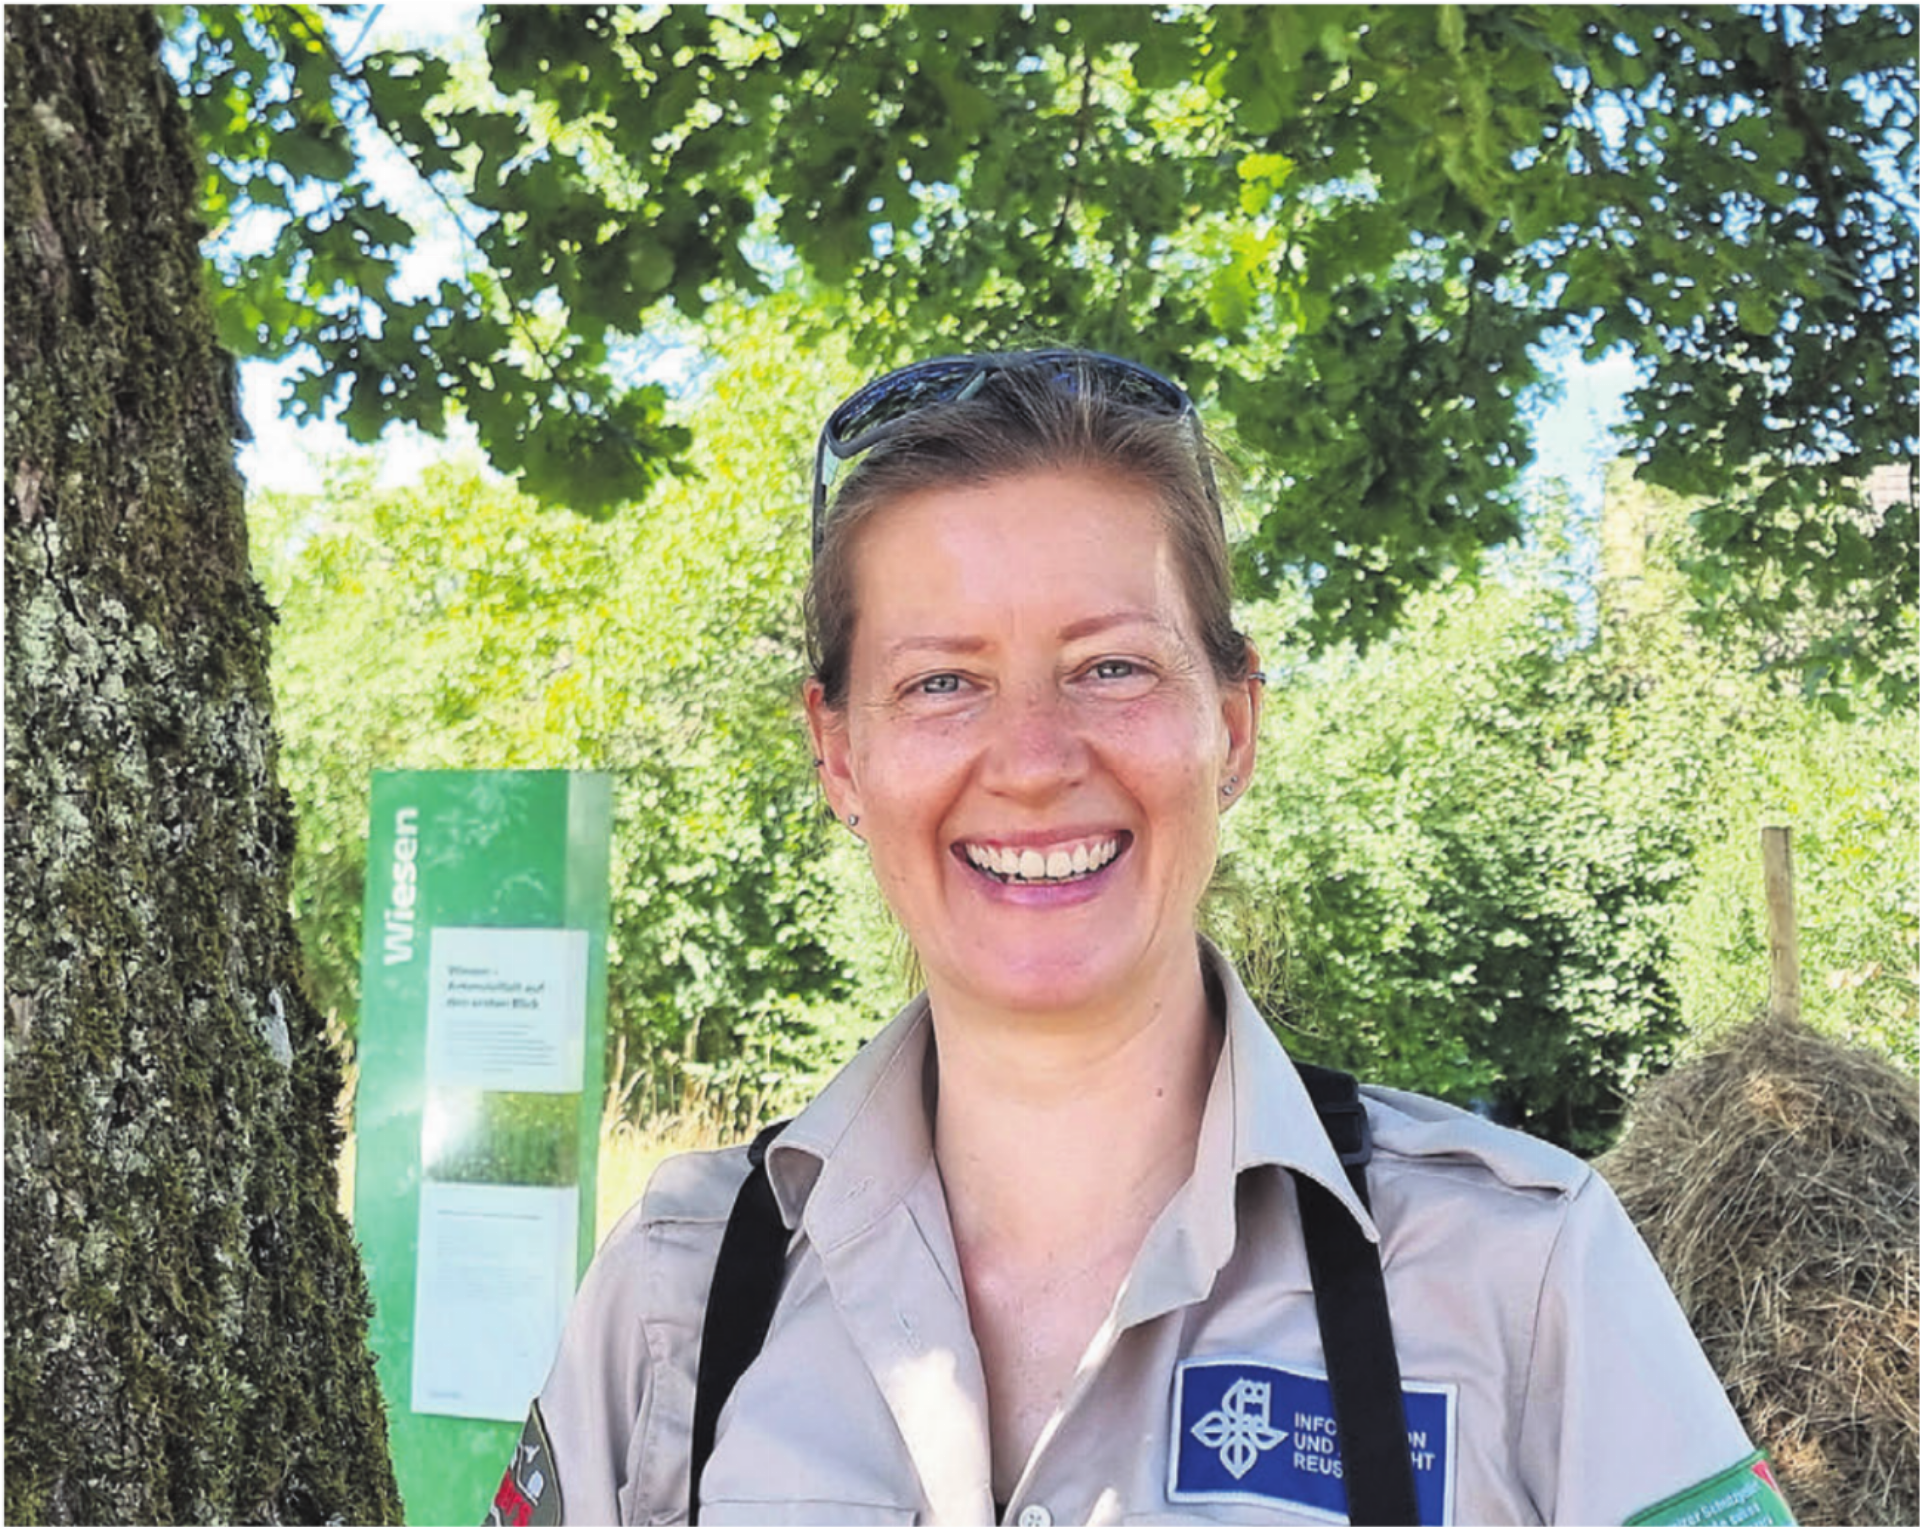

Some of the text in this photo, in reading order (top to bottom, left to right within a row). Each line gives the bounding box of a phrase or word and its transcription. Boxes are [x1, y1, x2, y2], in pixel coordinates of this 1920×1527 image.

[383, 807, 419, 966] Wiesen
[1293, 1431, 1334, 1455] UND
[1293, 1450, 1344, 1479] REUS
